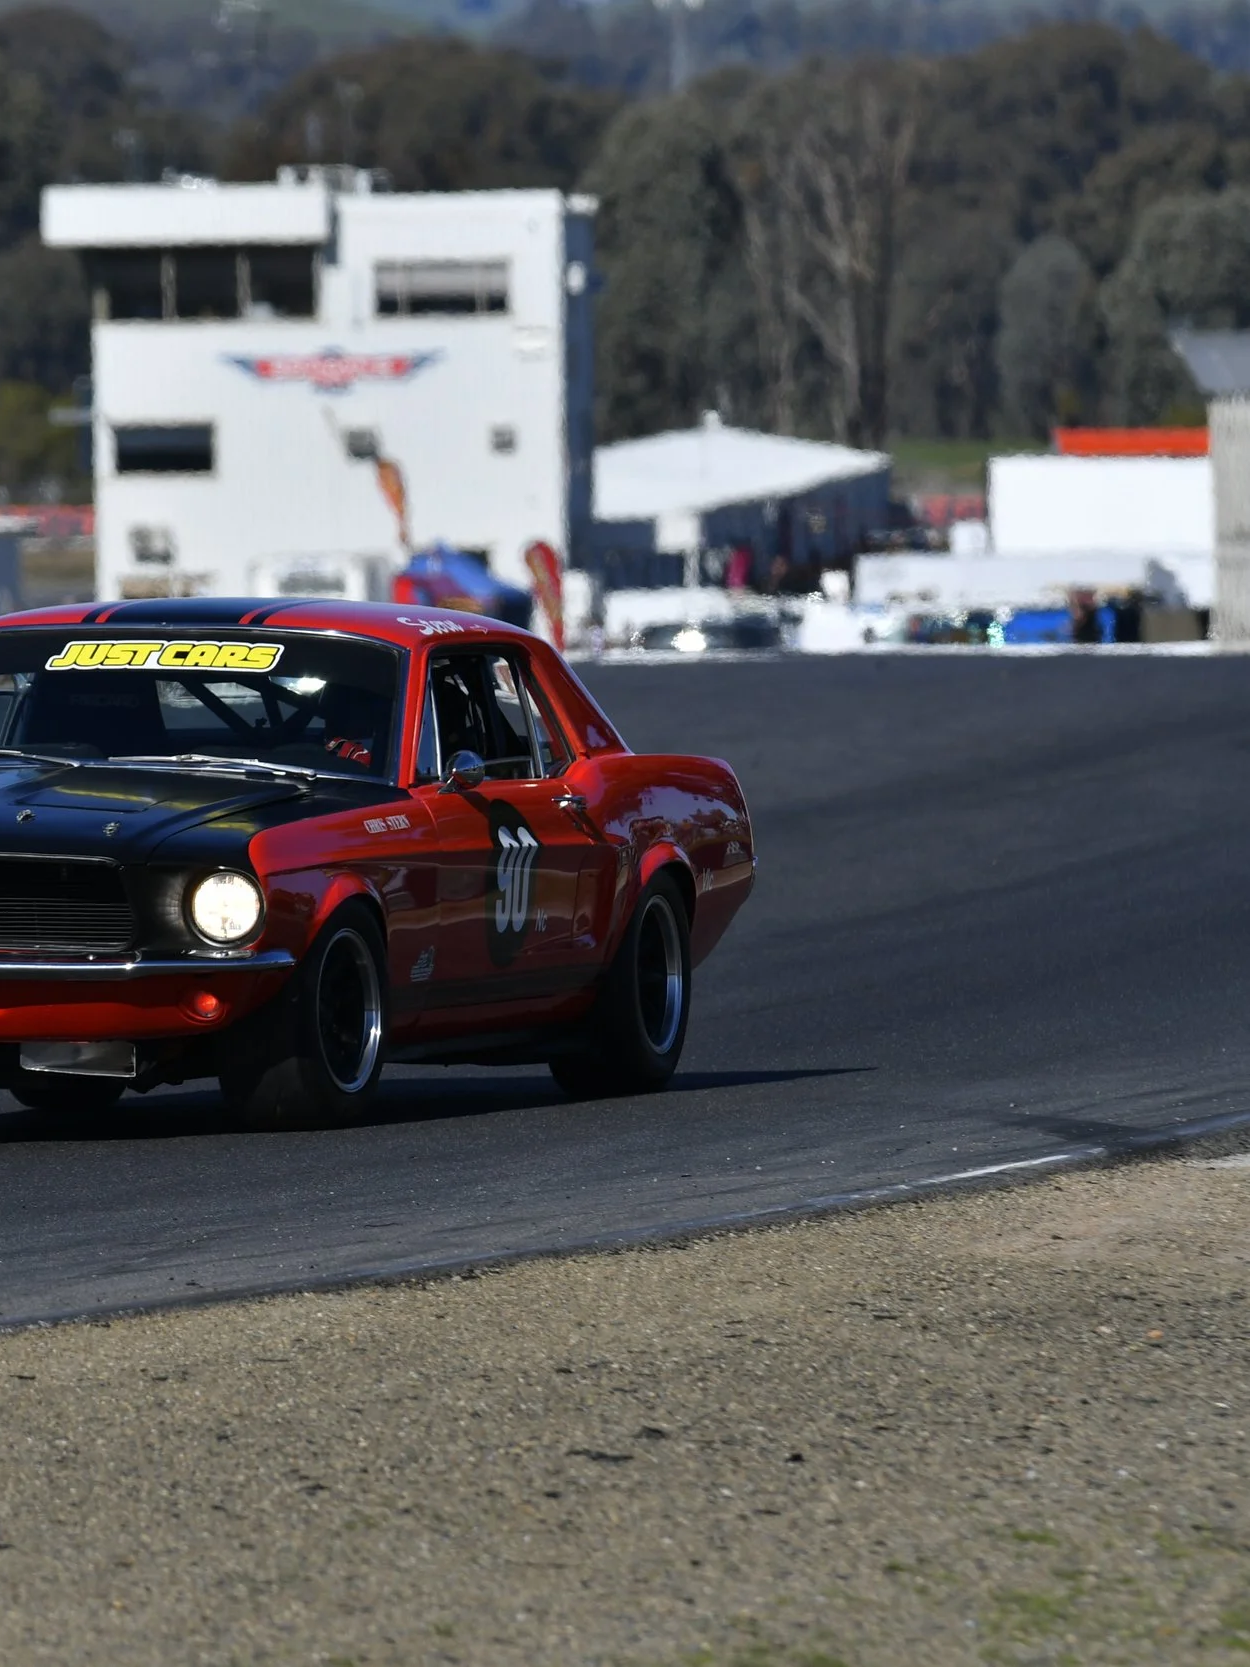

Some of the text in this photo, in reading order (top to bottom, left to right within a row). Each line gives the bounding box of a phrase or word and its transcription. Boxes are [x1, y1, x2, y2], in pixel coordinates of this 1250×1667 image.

[50, 642, 280, 670] JUST CARS
[495, 825, 539, 933] 90
